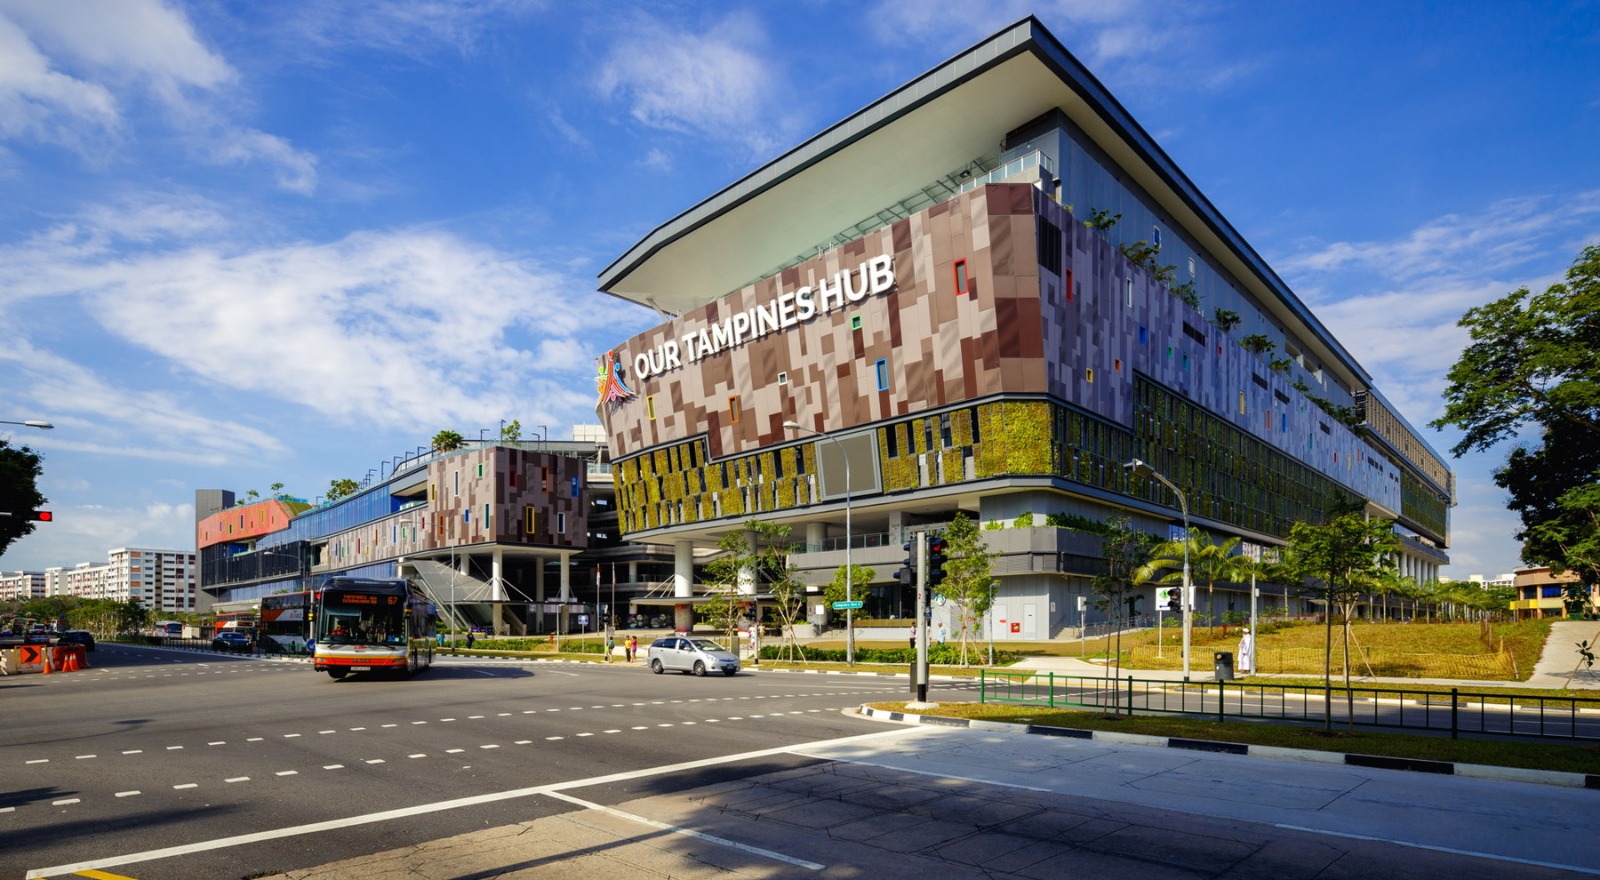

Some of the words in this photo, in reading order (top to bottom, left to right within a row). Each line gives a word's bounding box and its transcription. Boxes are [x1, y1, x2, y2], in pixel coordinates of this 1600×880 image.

[634, 339, 682, 380] OUR
[681, 285, 816, 363] TAMPINES
[819, 253, 896, 313] HUB
[387, 595, 398, 605] 67
